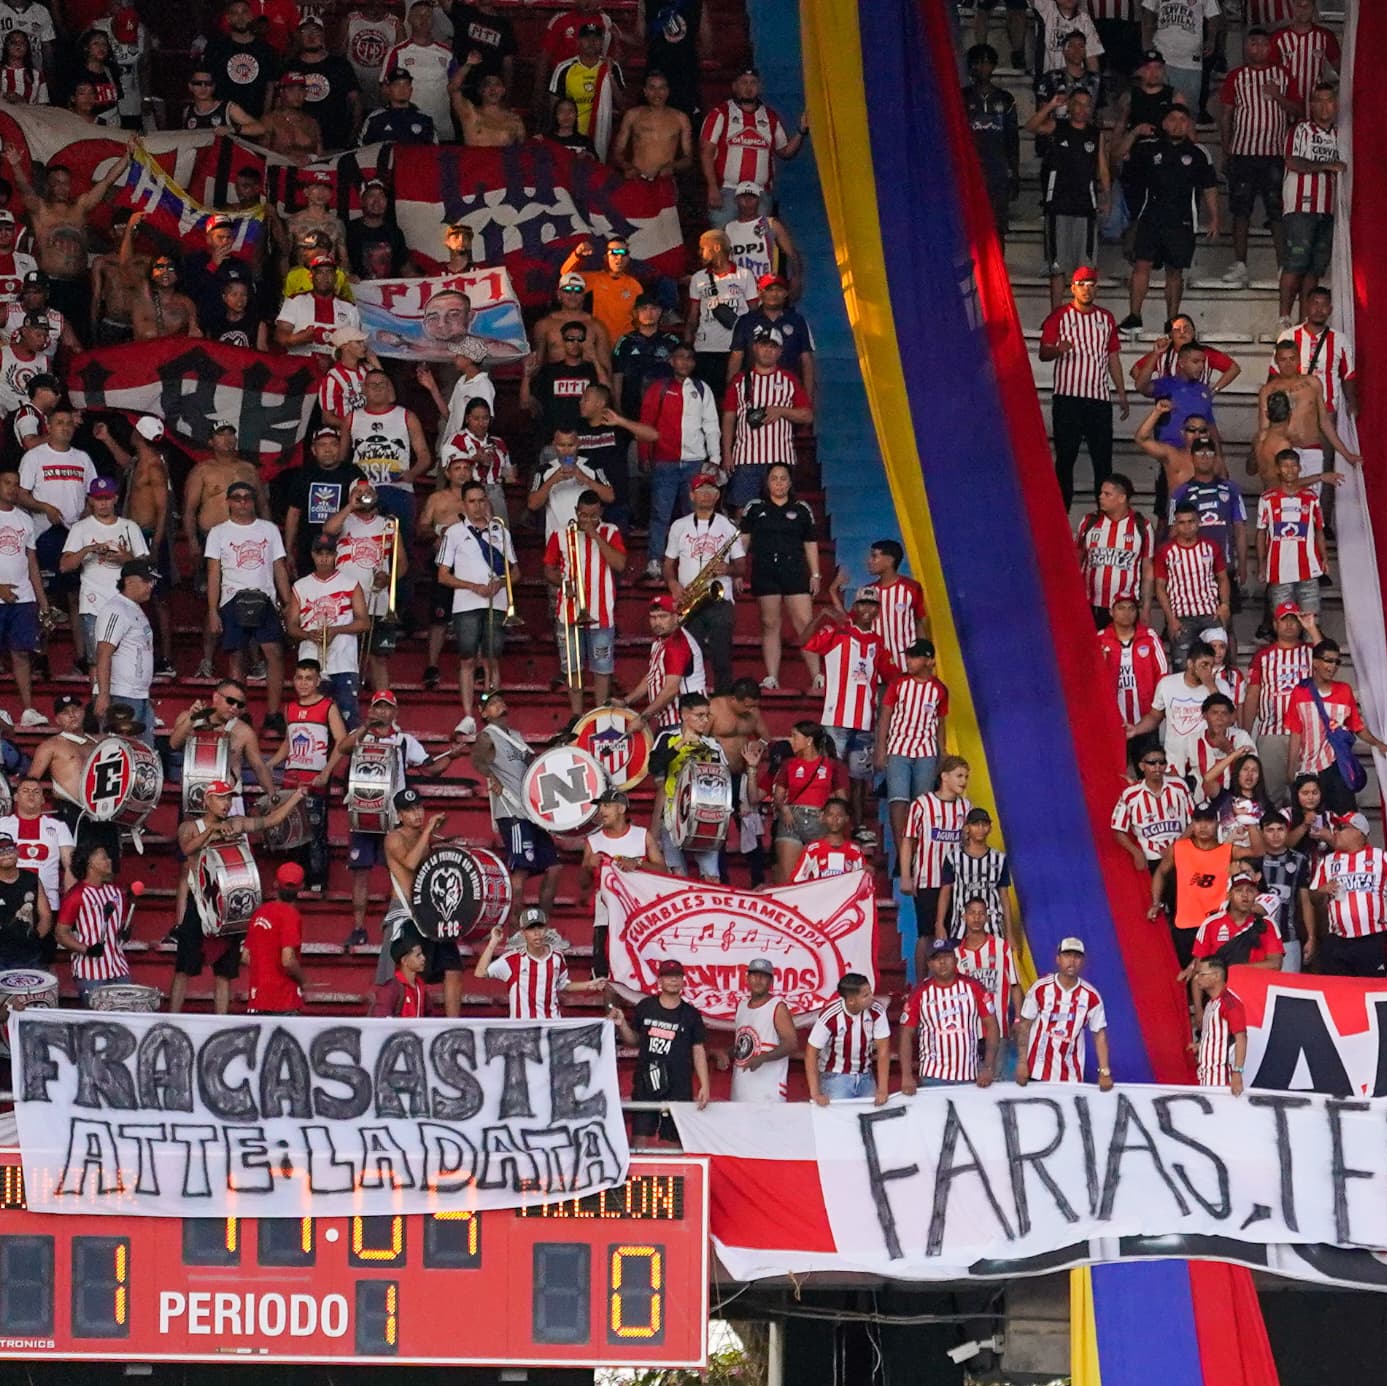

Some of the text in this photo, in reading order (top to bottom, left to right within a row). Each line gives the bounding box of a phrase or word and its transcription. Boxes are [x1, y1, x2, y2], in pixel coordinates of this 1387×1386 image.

[1141, 820, 1182, 838] AGUILA
[19, 1019, 608, 1121] FRACASASTE
[858, 1093, 1273, 1260] FARIAS,
[158, 1291, 349, 1338] PERIODO
[612, 1246, 663, 1338] 0
